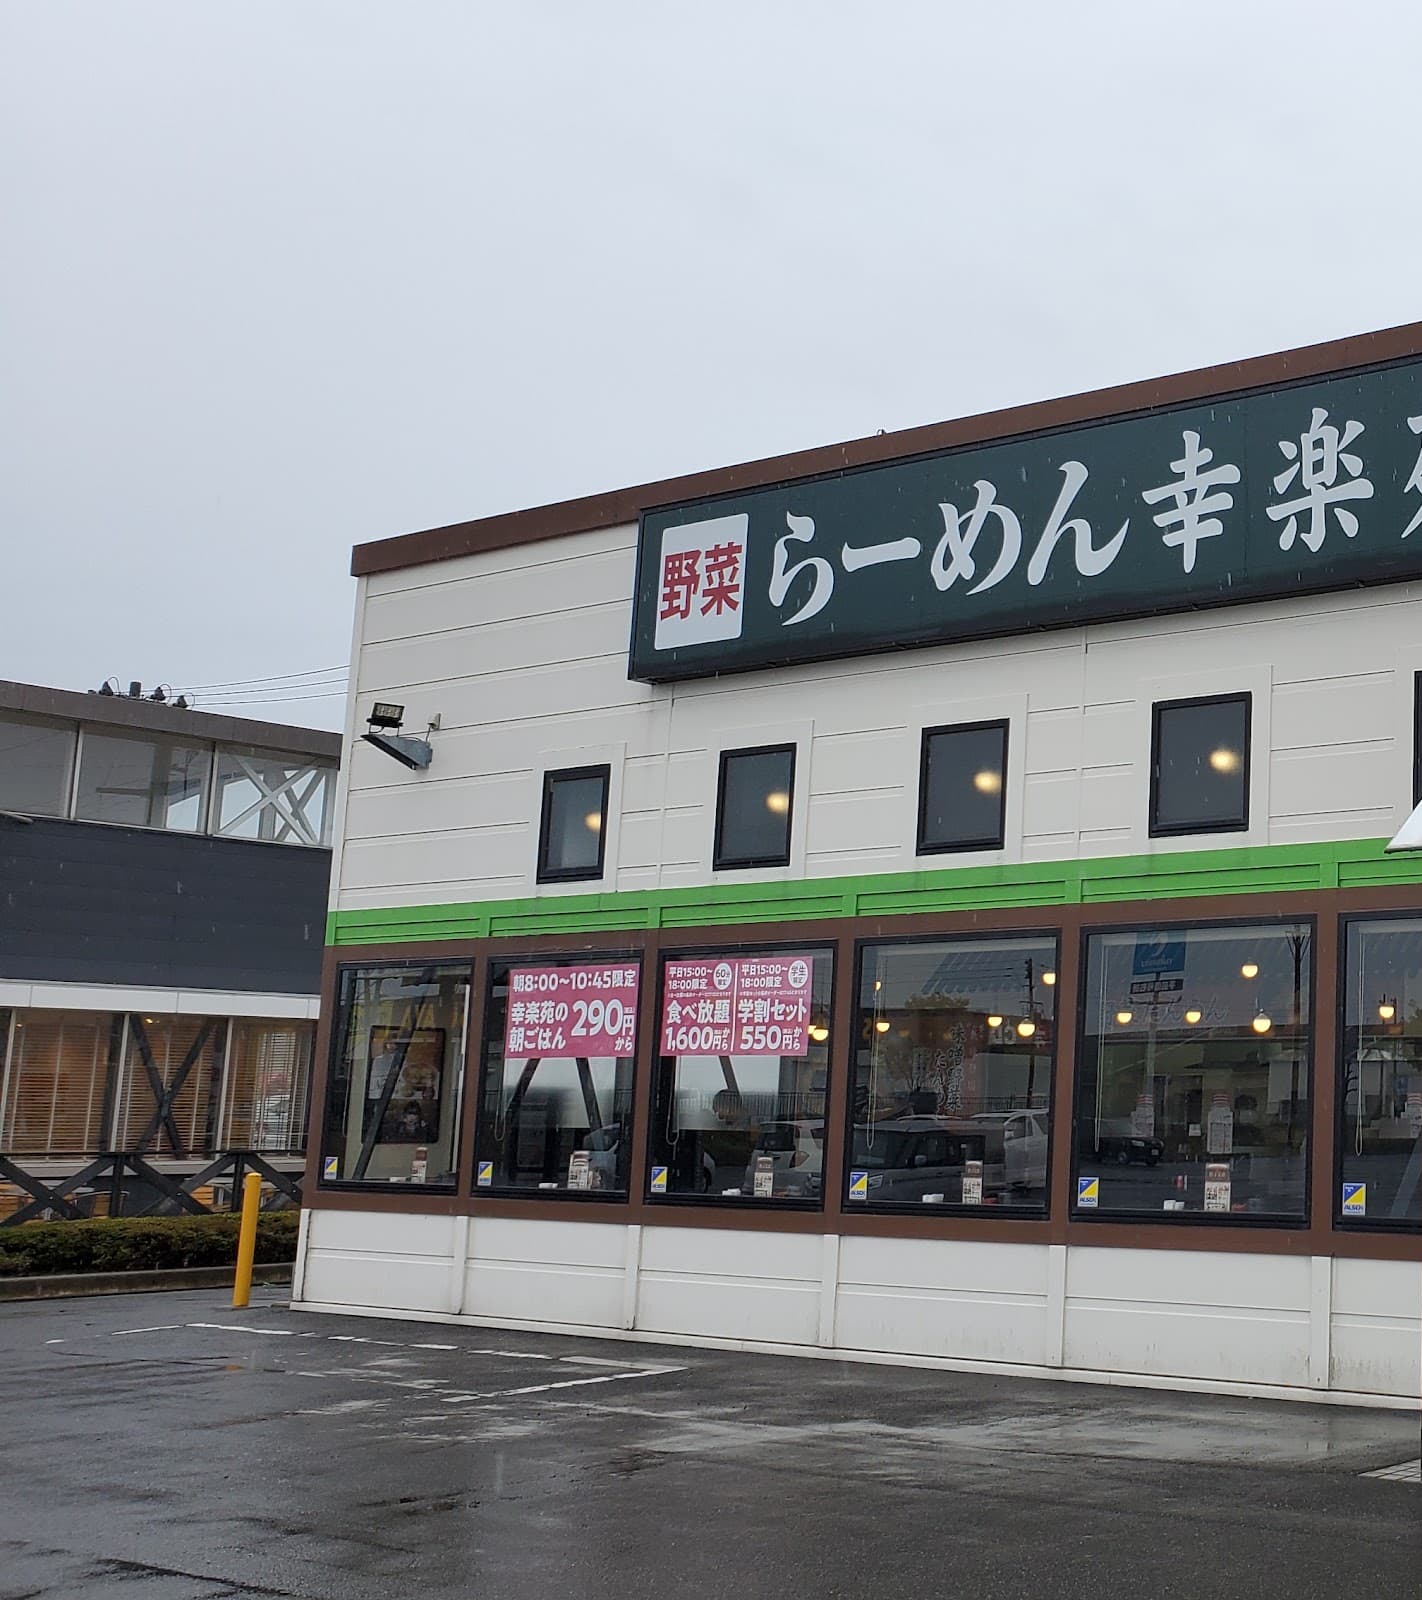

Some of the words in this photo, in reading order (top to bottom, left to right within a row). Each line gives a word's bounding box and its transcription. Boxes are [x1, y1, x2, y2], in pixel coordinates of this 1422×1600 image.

[660, 541, 743, 622] 野菜
[511, 1000, 569, 1025] 幸楽苑の
[666, 999, 731, 1024] 食べ放題
[738, 998, 808, 1023] 学割セット
[508, 1027, 566, 1052] 朝ごはん
[614, 1036, 633, 1051] から
[721, 1027, 731, 1051] から
[793, 1026, 803, 1051] から
